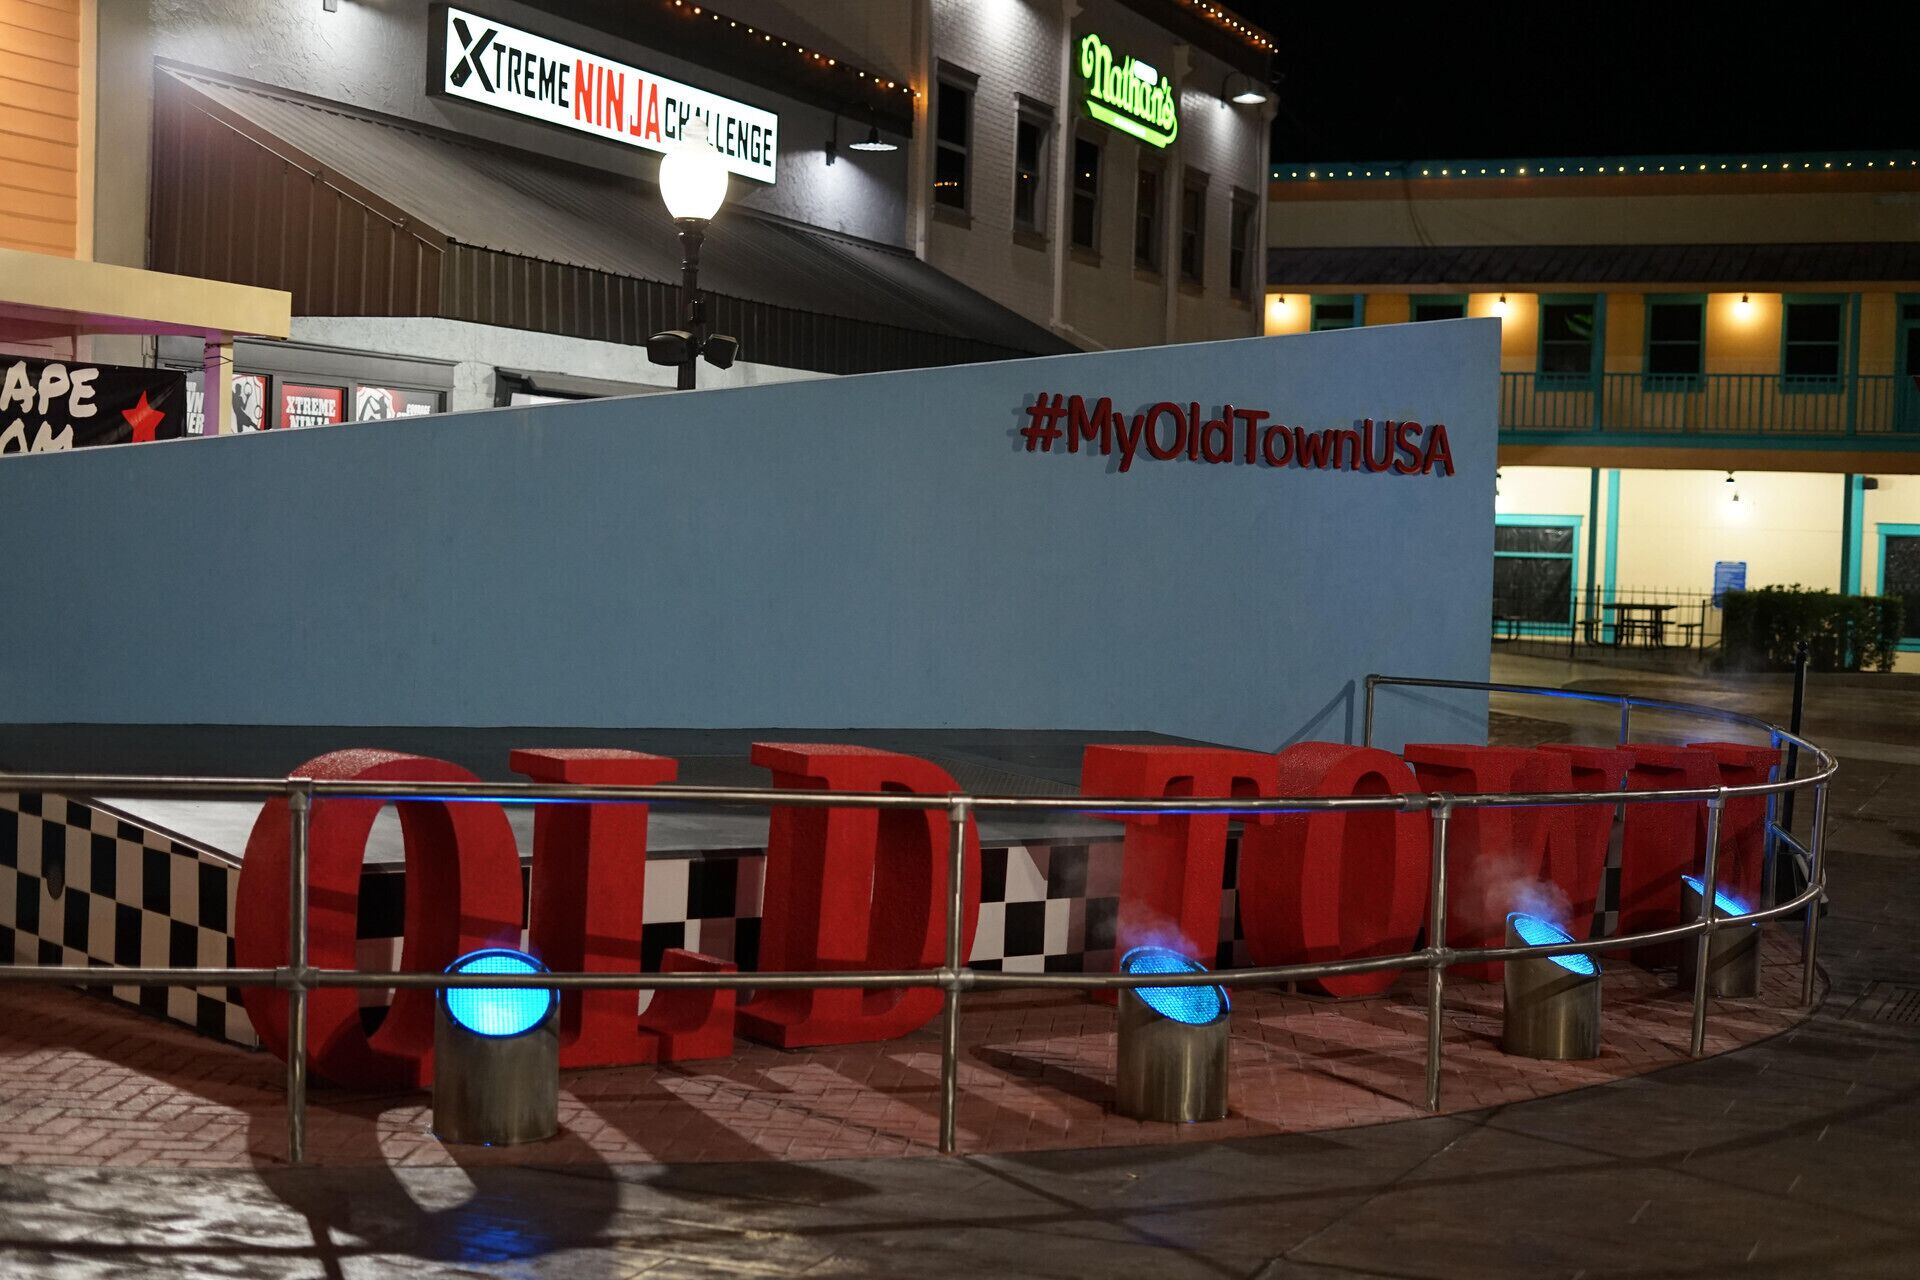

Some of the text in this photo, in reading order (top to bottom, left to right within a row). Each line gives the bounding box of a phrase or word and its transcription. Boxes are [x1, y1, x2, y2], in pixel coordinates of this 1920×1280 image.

[450, 17, 773, 168] XTREME NINJA CHLLENGE
[1082, 33, 1175, 131] Nathan's
[286, 395, 336, 417] XTREME
[1020, 392, 1455, 477] #MyOldTownUSA
[235, 742, 1782, 1090] OLD TOWN
